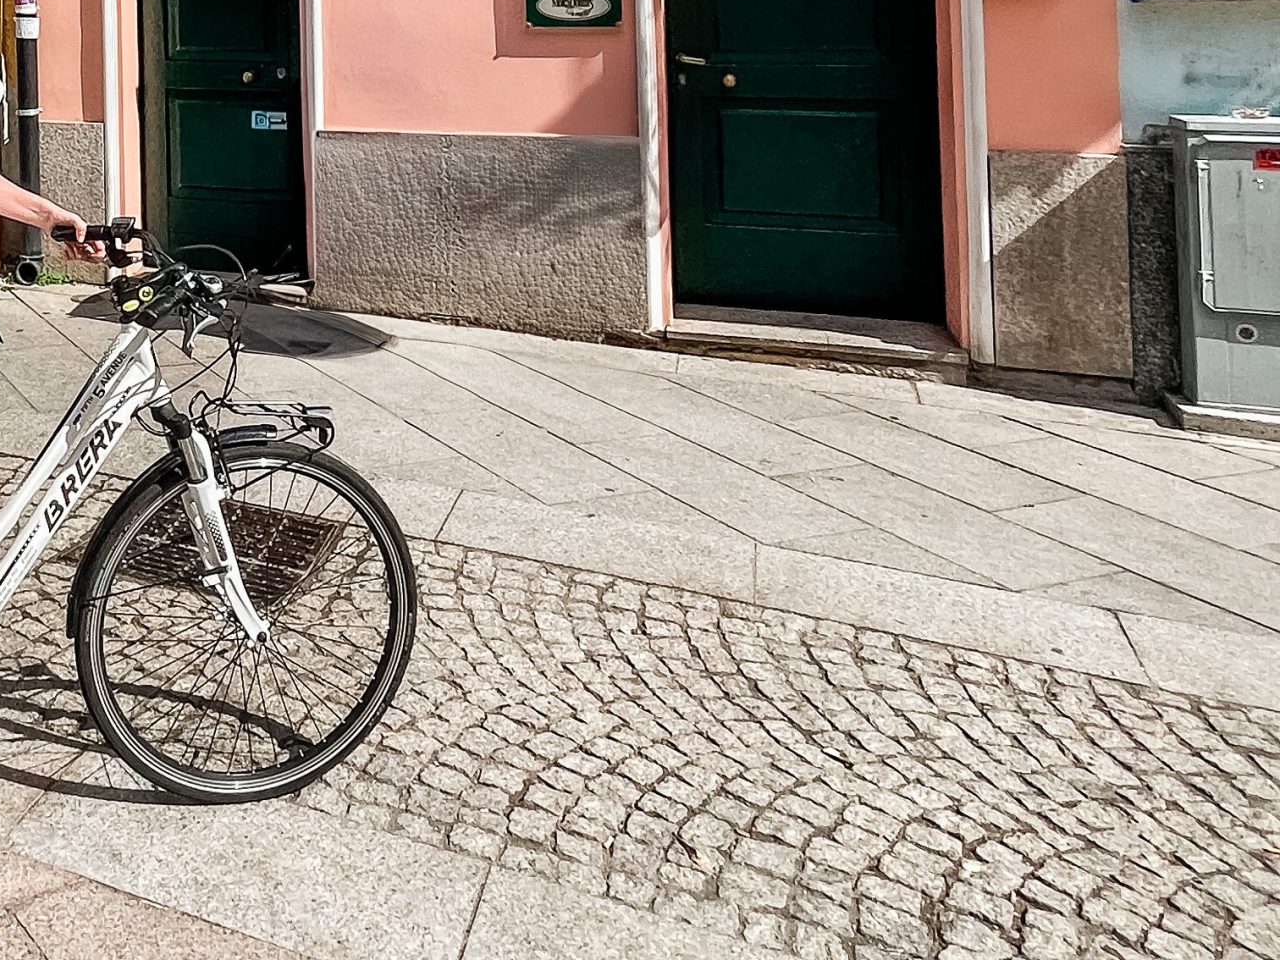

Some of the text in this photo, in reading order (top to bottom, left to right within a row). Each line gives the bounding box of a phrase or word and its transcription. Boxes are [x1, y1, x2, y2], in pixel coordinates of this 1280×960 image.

[92, 385, 106, 400] 5
[100, 350, 128, 388] AVENUE
[43, 418, 123, 533] BRERA
